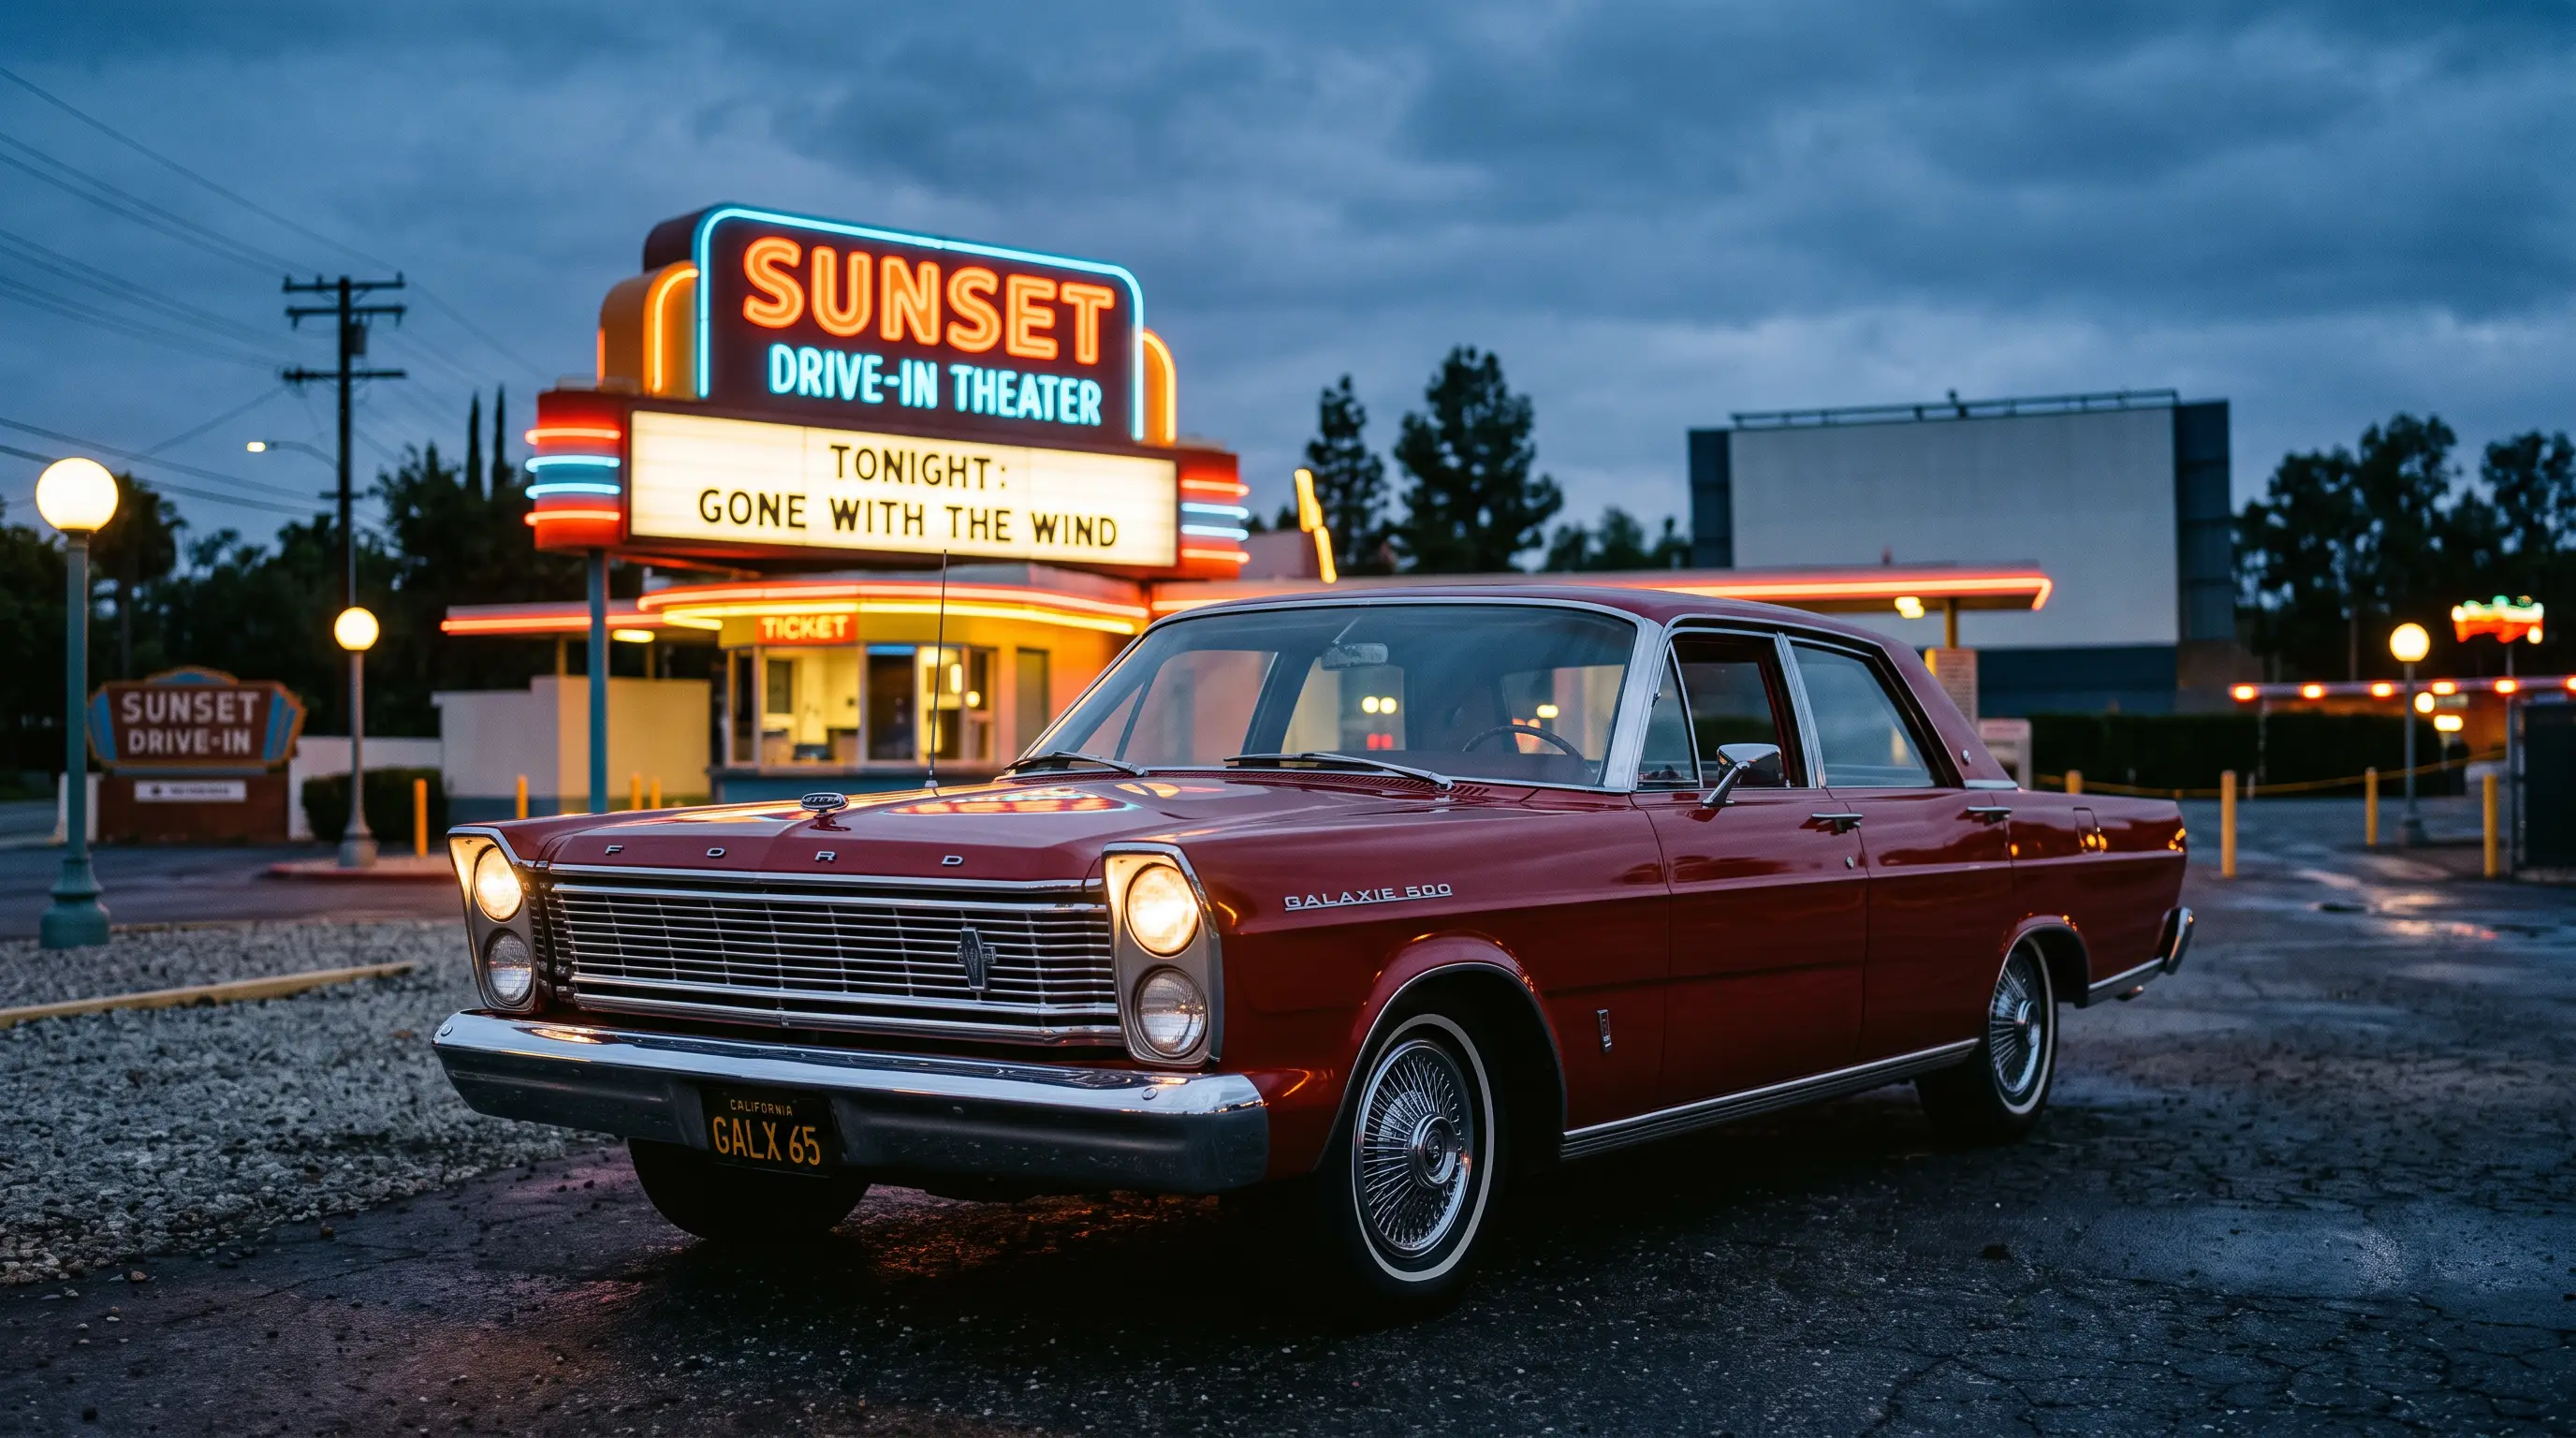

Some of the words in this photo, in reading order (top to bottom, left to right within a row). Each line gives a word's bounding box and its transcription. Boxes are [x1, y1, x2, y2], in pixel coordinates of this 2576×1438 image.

[743, 237, 1115, 364] SUNSET
[768, 343, 937, 409] DRIVE-IN
[949, 363, 1103, 426] THEATER
[830, 445, 1008, 490] TONIGHT:
[699, 489, 806, 529] GONE
[830, 497, 924, 536] WITH
[945, 506, 1012, 542] THE
[1032, 512, 1117, 548] WIND
[761, 615, 850, 639] TICKET
[122, 690, 260, 724] SUNSET
[127, 727, 251, 755] DRIVE-IN
[1284, 888, 1397, 908] GALAXIE
[730, 1098, 793, 1117] CALIFORNIA
[712, 1116, 783, 1162] GALX
[789, 1125, 821, 1166] 65
